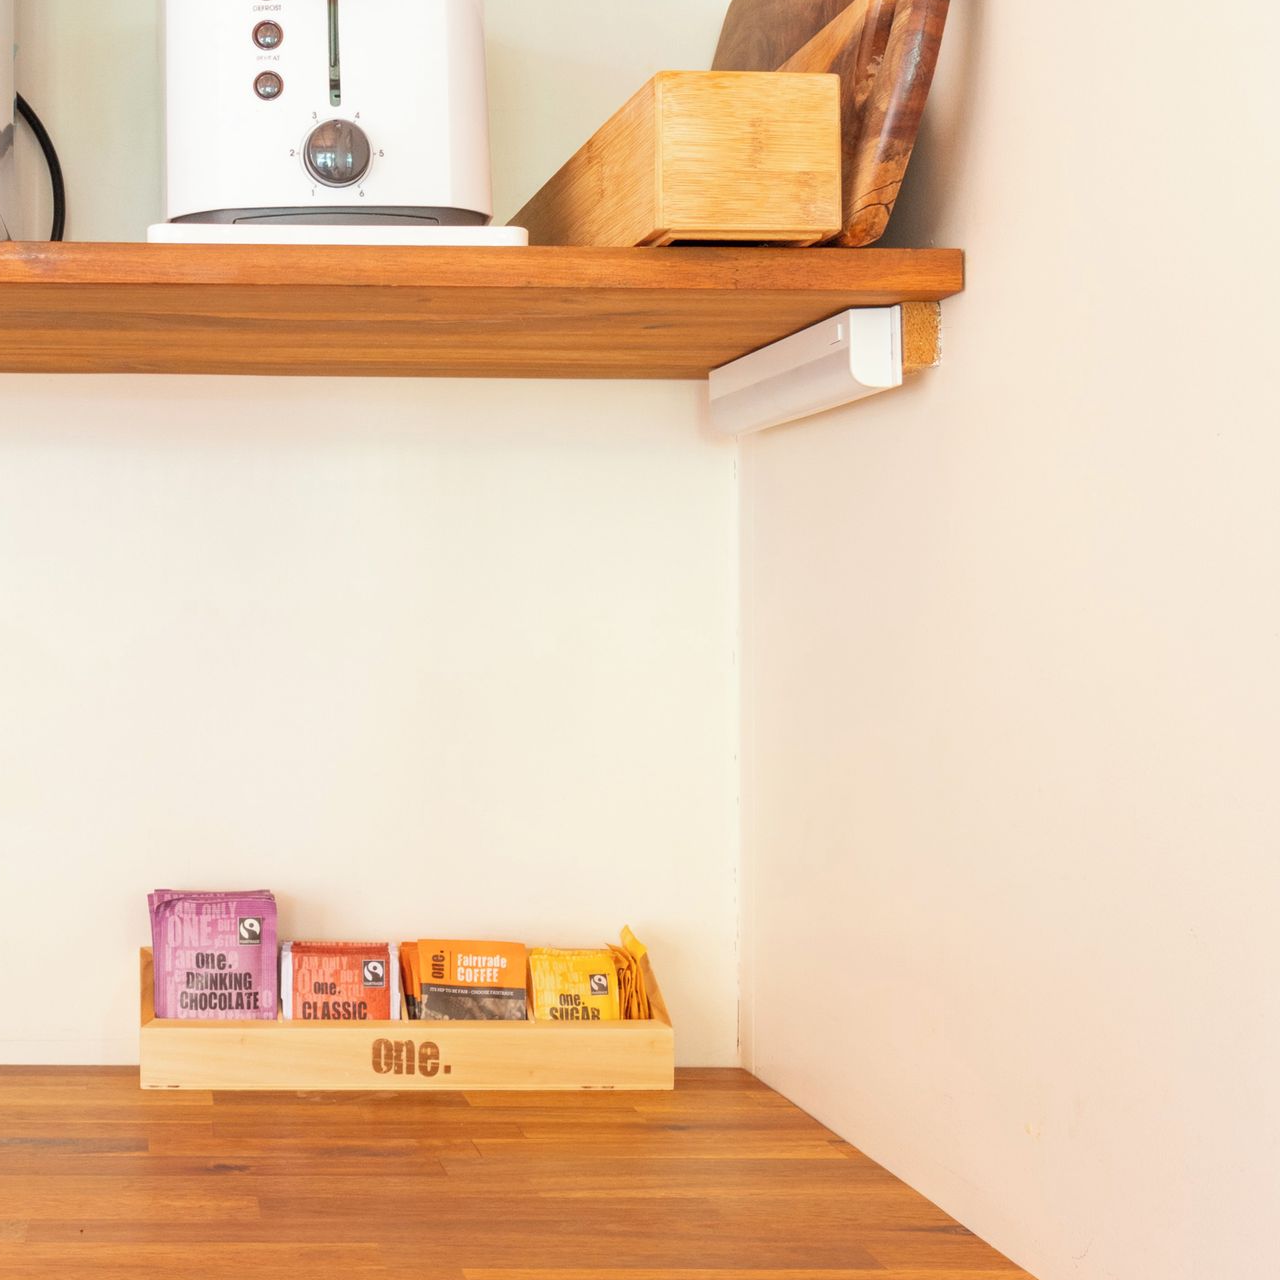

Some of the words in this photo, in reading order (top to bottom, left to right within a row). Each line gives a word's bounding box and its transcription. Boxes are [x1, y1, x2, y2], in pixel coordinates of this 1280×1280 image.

[252, 4, 282, 12] DEFROST
[289, 149, 295, 157] 2
[195, 952, 232, 970] one.
[432, 950, 445, 979] one.
[457, 954, 507, 968] Fairtrade
[186, 972, 252, 990] DRINKING
[457, 967, 499, 982] COFFEE
[313, 981, 342, 995] one.
[180, 991, 259, 1011] CHOCOLATE
[559, 993, 585, 1006] one.
[302, 1001, 367, 1020] CLASSIC
[550, 1006, 600, 1020] SUGAR
[372, 1038, 451, 1077] one.
